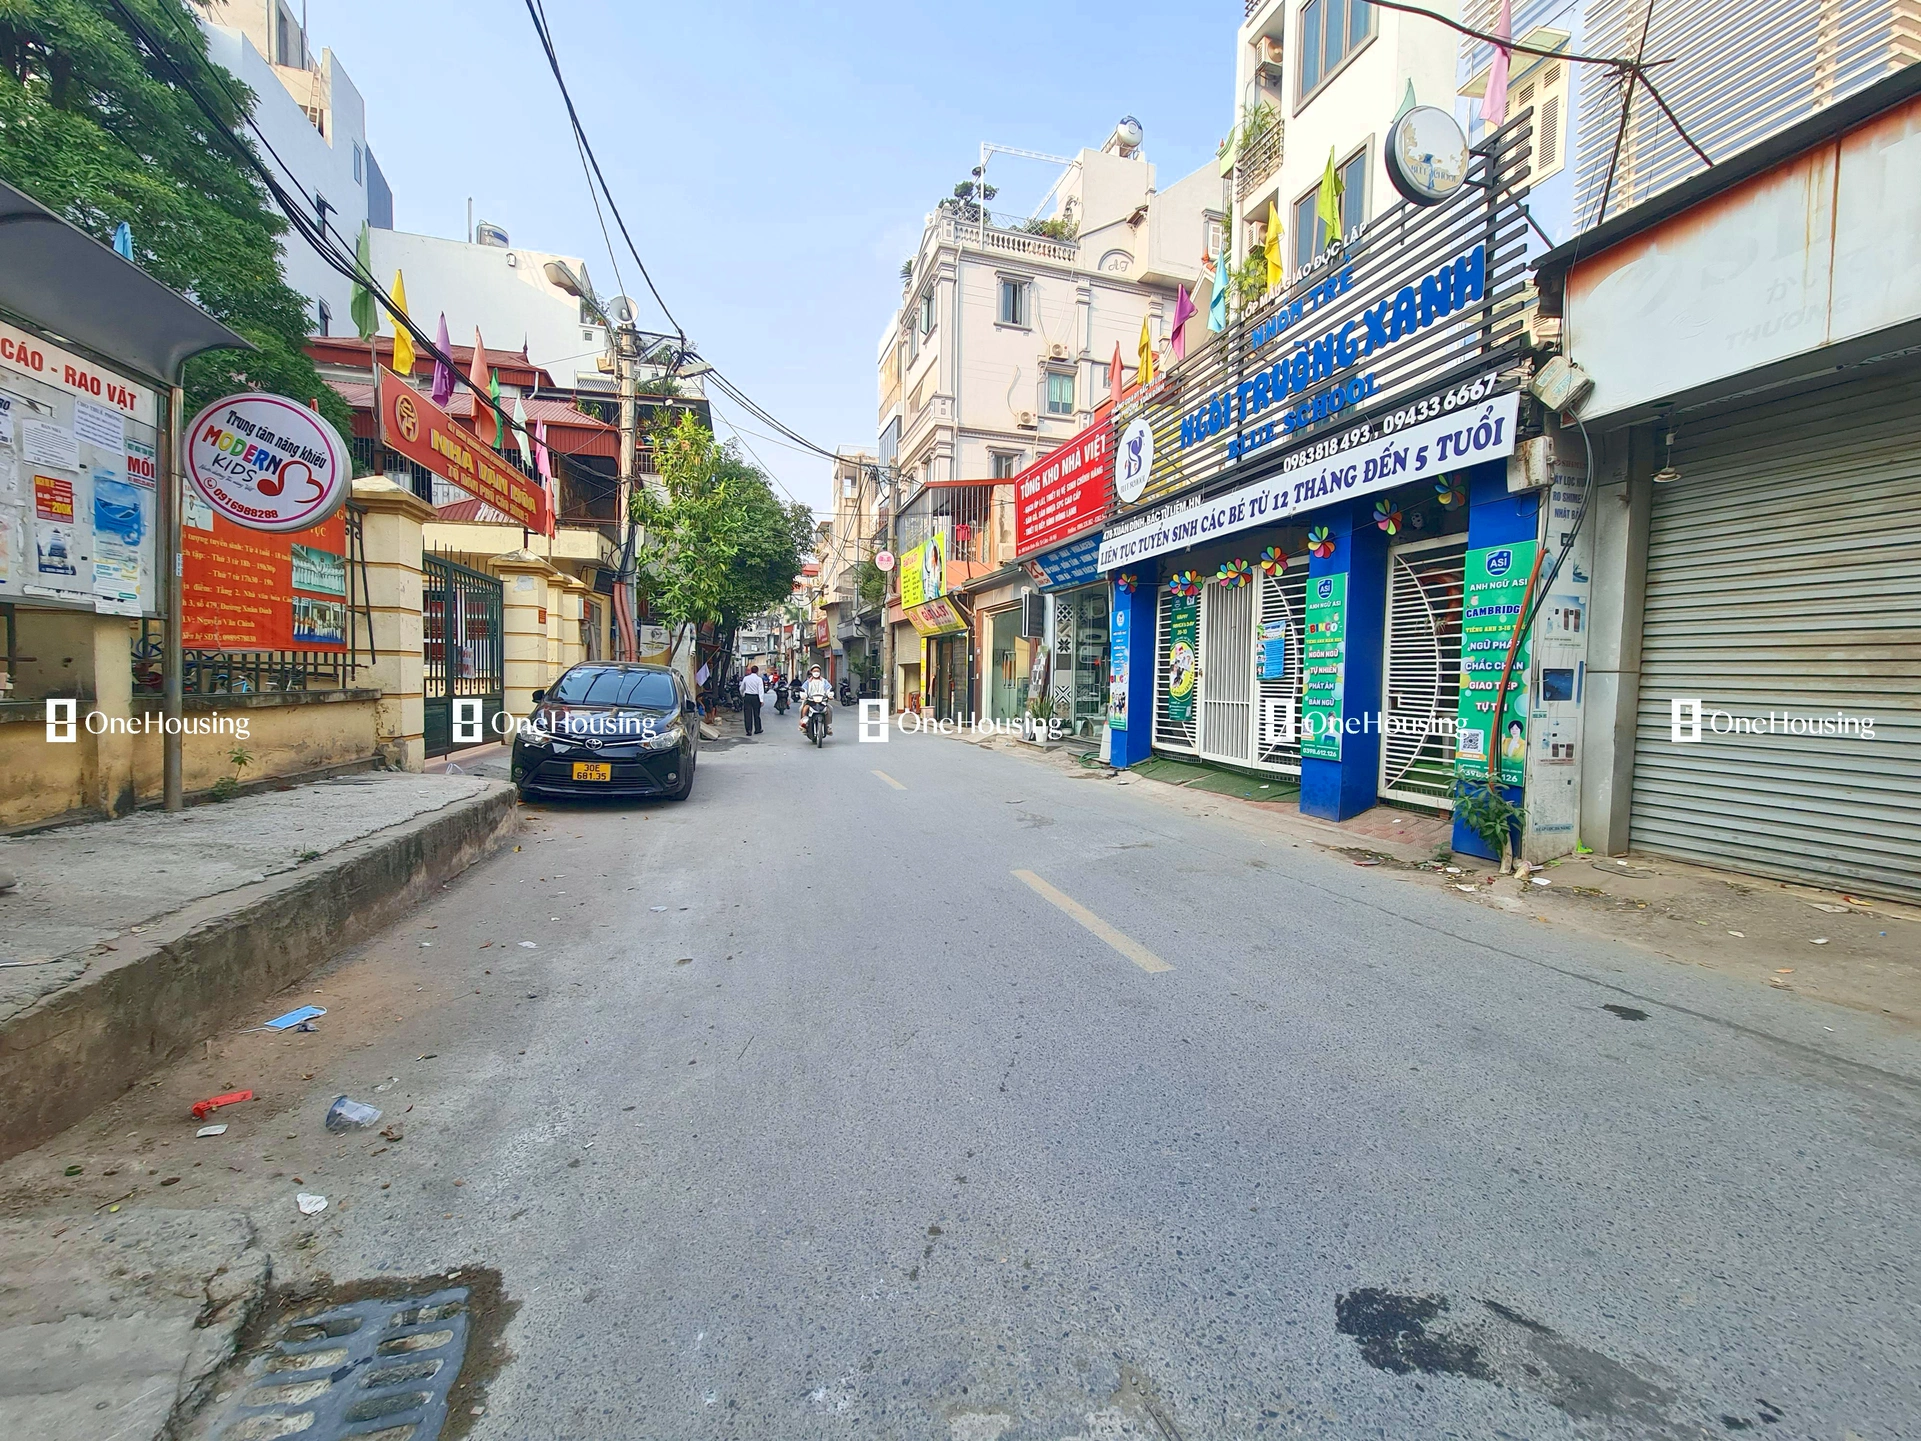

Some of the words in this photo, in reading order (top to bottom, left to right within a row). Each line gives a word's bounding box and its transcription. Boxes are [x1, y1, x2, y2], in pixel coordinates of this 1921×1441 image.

[1251, 296, 1304, 350] NHÓM
[1308, 254, 1354, 311] TRẺ
[1180, 391, 1231, 450] NGÔI
[1363, 244, 1486, 356] XANH
[1, 338, 44, 372] CÁO
[64, 364, 102, 396] RAO
[107, 383, 137, 411] VẶT
[1228, 420, 1276, 462] BLUE
[1284, 372, 1382, 435] SCHOOL
[1283, 438, 1338, 472] 0983818
[1338, 424, 1370, 451] 493
[1383, 397, 1440, 434] 09433
[1444, 372, 1497, 411] 6667
[226, 410, 256, 436] Trung
[256, 426, 276, 444] tâm
[275, 437, 300, 458] năng
[300, 446, 327, 469] khiếu
[202, 425, 284, 476] MODERN
[212, 453, 257, 482] KIDS
[430, 428, 474, 474] NHÀ
[477, 460, 508, 496] VĂN
[510, 485, 536, 516] HÓA
[1021, 475, 1040, 500] TỔNG
[1042, 463, 1060, 488] KHO
[1062, 448, 1082, 477] NHÀ
[1084, 434, 1106, 464] VIỆT
[446, 464, 459, 481] TỔ
[461, 472, 478, 493] DÂN
[480, 484, 494, 502] PHỐ
[1100, 545, 1118, 566] LIÊN
[1120, 541, 1136, 562] TỤC
[1138, 522, 1170, 554] TUYỂN
[1172, 520, 1198, 543] SINH
[1201, 508, 1226, 533] CÁC
[1228, 498, 1245, 525] BÉ
[1249, 490, 1270, 518] TỪ
[1273, 491, 1289, 511] 12
[1294, 468, 1357, 504] THÁNG
[1363, 441, 1410, 483] ĐẾN
[1415, 445, 1428, 472] 5
[1436, 405, 1506, 462] TUỔI
[1564, 476, 1575, 488] LỌC
[213, 488, 278, 518] 0916988288
[1554, 507, 1570, 521] NHẬT
[1470, 581, 1488, 592] ANH
[1490, 578, 1510, 590] NGỮ
[1512, 578, 1528, 586] ASI
[1466, 605, 1523, 618] CAMBRIDG
[1310, 622, 1338, 634] BINGO
[1470, 639, 1491, 650] NGỮ
[1309, 649, 1324, 658] NGÔN
[1326, 648, 1338, 657] NGỮ
[1319, 666, 1336, 674] NHIÊN
[1466, 658, 1492, 670] CHẮC
[1309, 681, 1324, 689] PHÁT
[1324, 681, 1334, 689] ÂM
[1469, 682, 1492, 690] GIAO
[1322, 697, 1334, 706] NGỮ
[1476, 702, 1490, 712] TỰ
[584, 764, 600, 772] 30E
[576, 772, 606, 780] 681.35
